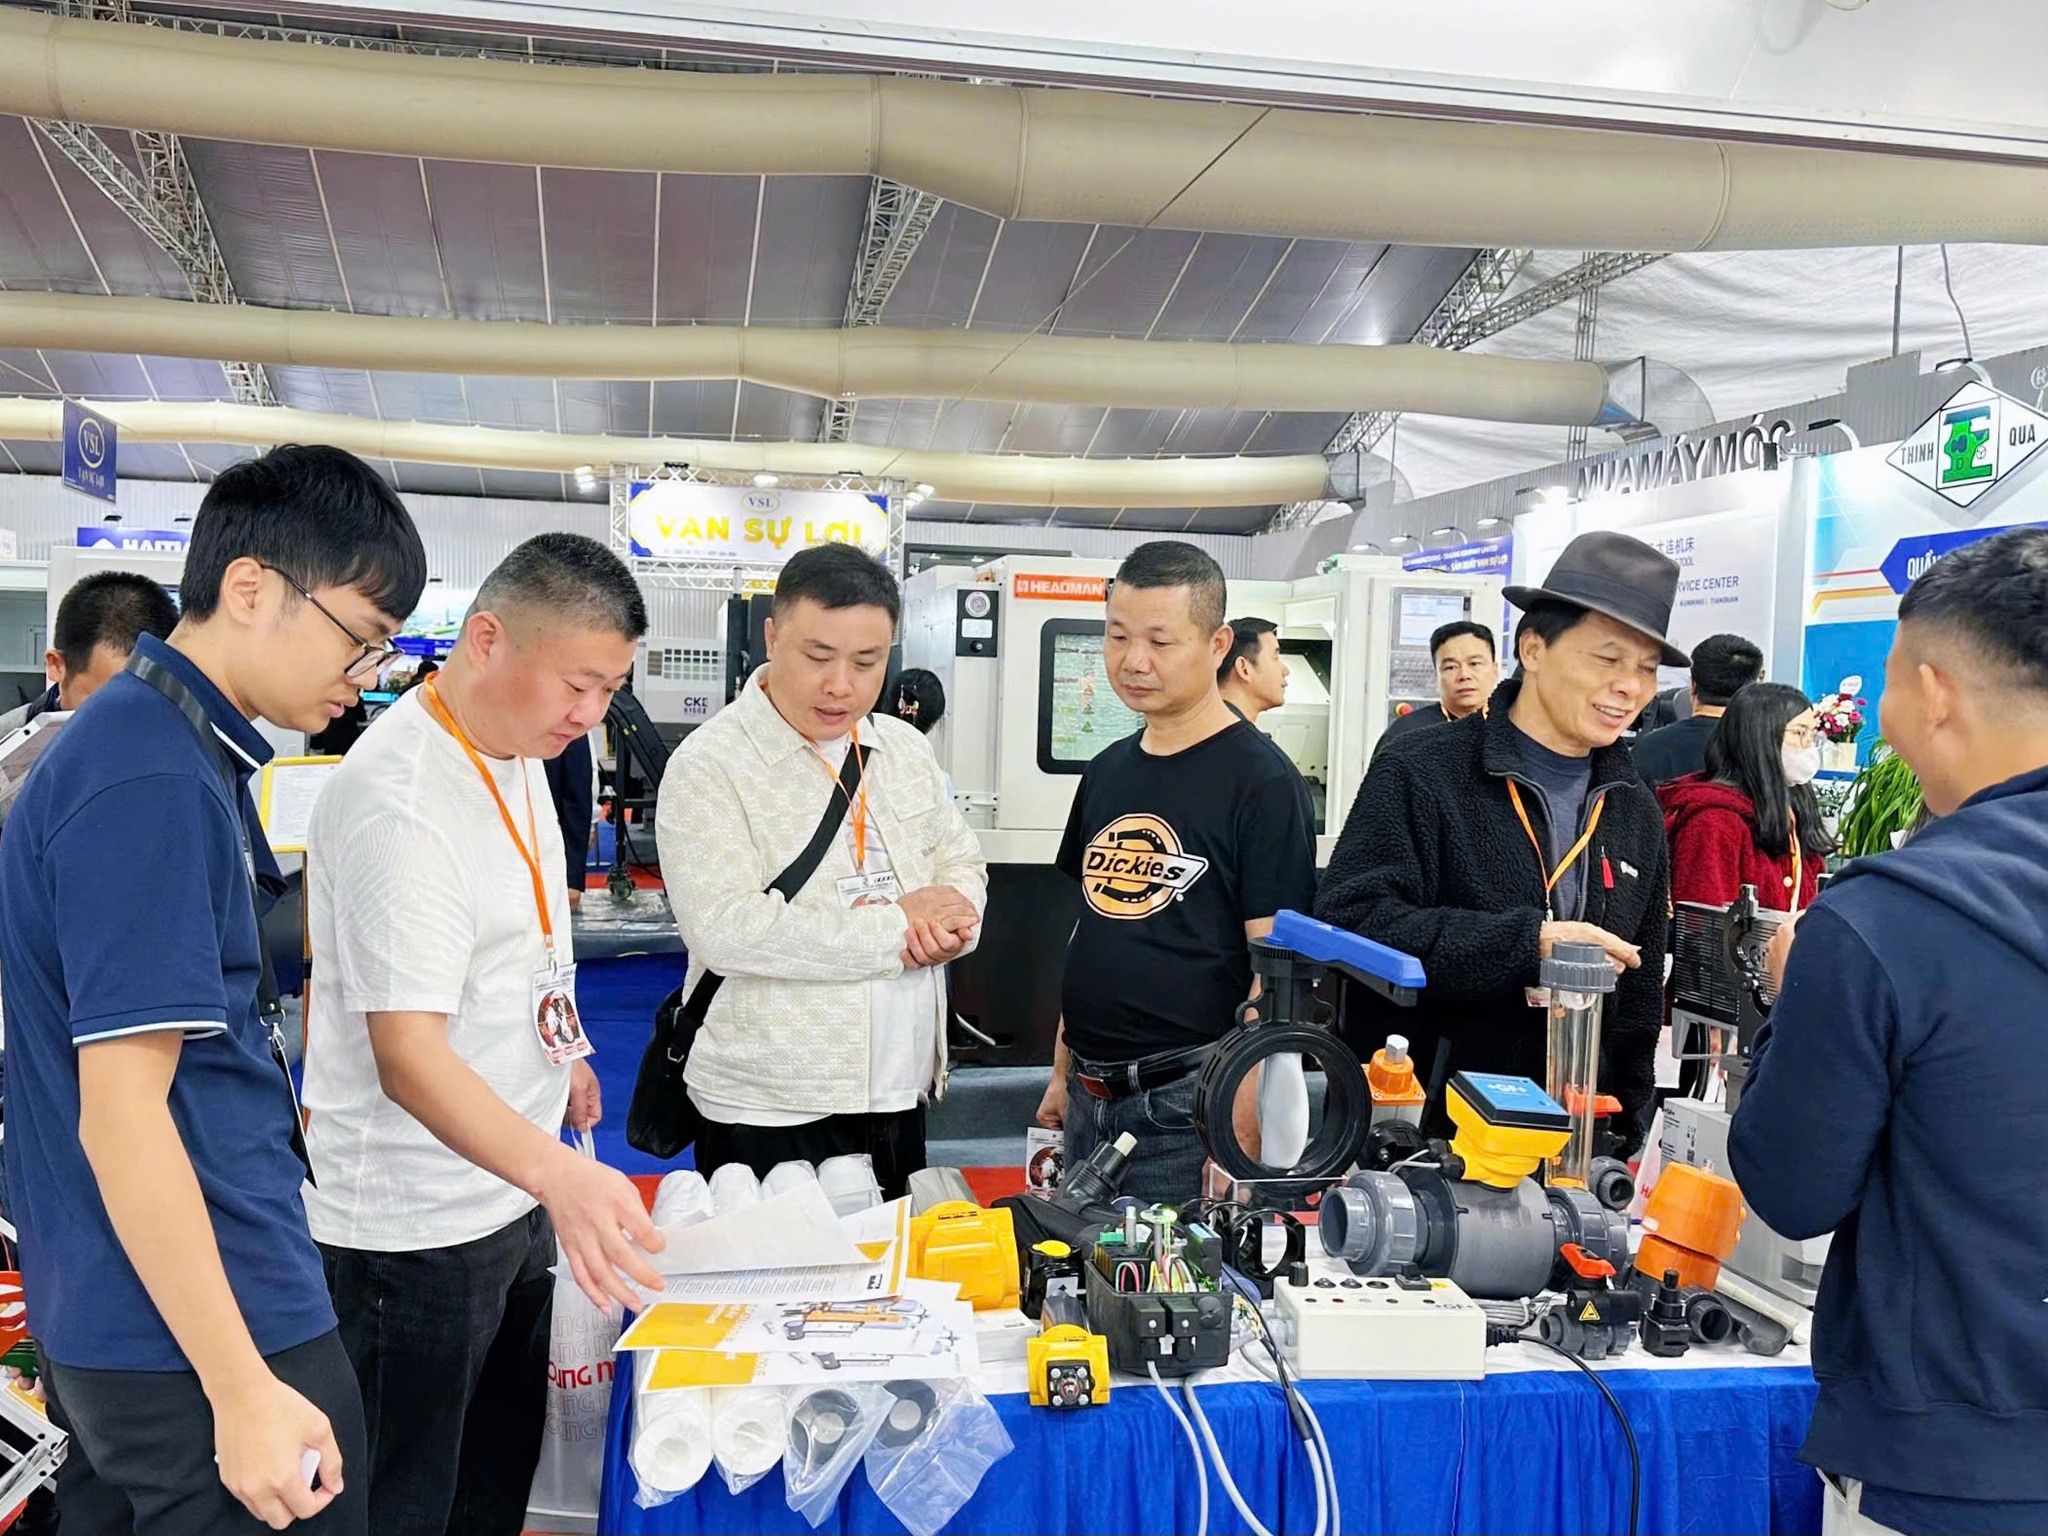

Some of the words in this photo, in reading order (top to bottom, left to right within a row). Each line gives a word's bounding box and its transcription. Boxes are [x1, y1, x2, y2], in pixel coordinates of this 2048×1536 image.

[83, 429, 101, 457] VSL
[2008, 423, 2036, 447] QUA
[748, 496, 775, 508] VSL
[655, 515, 730, 546] VẠN
[743, 516, 794, 551] SỰ
[1029, 580, 1103, 595] HEADMAN
[1702, 575, 1739, 590] CENTER
[1086, 850, 1186, 881] Dickies
